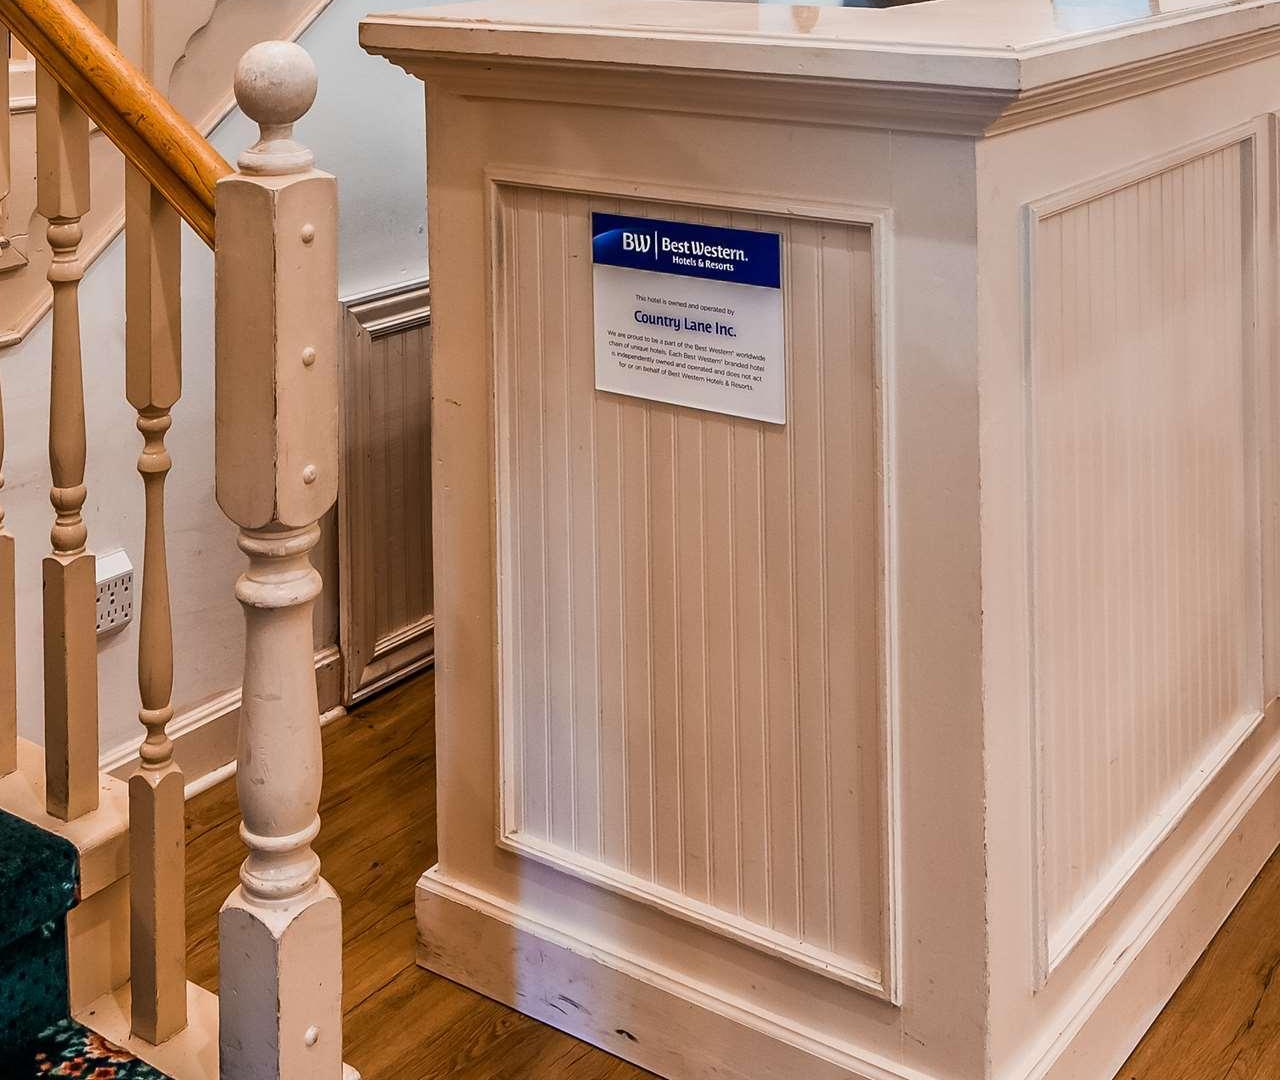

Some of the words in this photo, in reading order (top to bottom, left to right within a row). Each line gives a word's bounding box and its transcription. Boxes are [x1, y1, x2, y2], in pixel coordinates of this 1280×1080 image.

[622, 232, 650, 253] BW
[663, 238, 689, 253] Best
[673, 256, 696, 267] Hotels
[698, 259, 704, 267] &
[706, 261, 733, 271] Resorts
[634, 311, 680, 331] Country
[685, 317, 712, 334] Lane
[716, 322, 737, 337] Inc.
